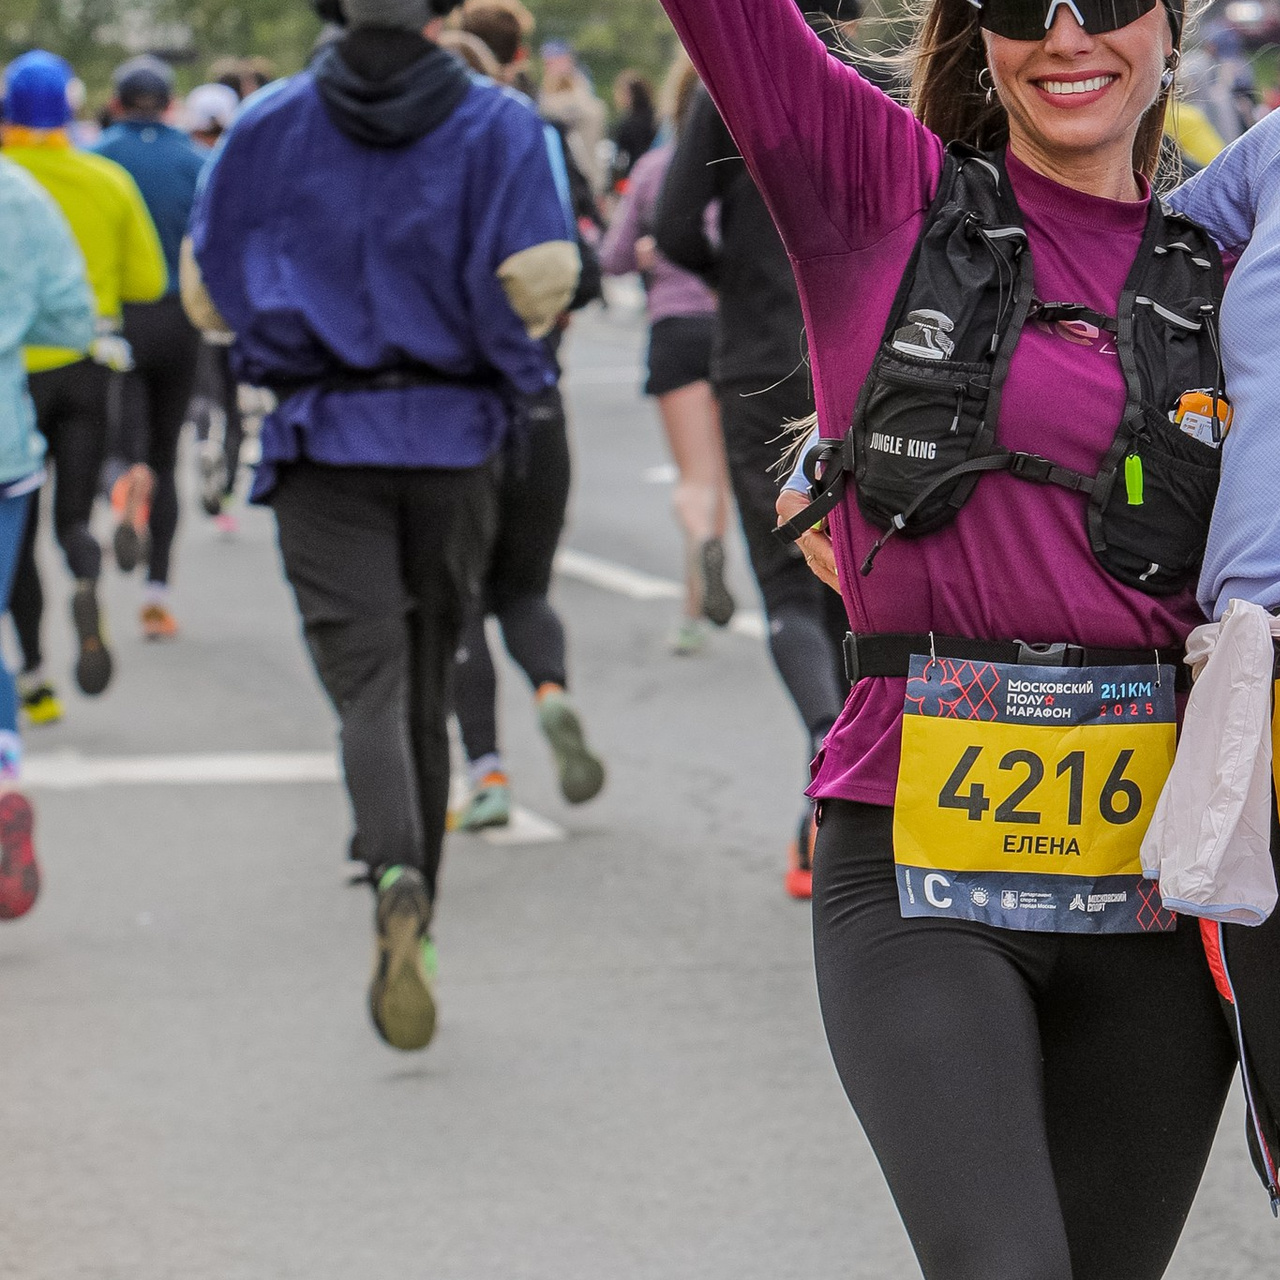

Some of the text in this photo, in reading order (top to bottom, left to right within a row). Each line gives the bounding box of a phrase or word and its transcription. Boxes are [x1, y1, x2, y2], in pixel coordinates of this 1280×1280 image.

[869, 432, 938, 461] JUNGLE KING
[1006, 693, 1045, 706] ПОЛУ
[1099, 702, 1154, 717] 2025
[1006, 706, 1072, 719] МАРАФОН
[938, 745, 1143, 826] 4216
[1003, 834, 1081, 856] ЕЛЕНА
[923, 873, 953, 909] C
